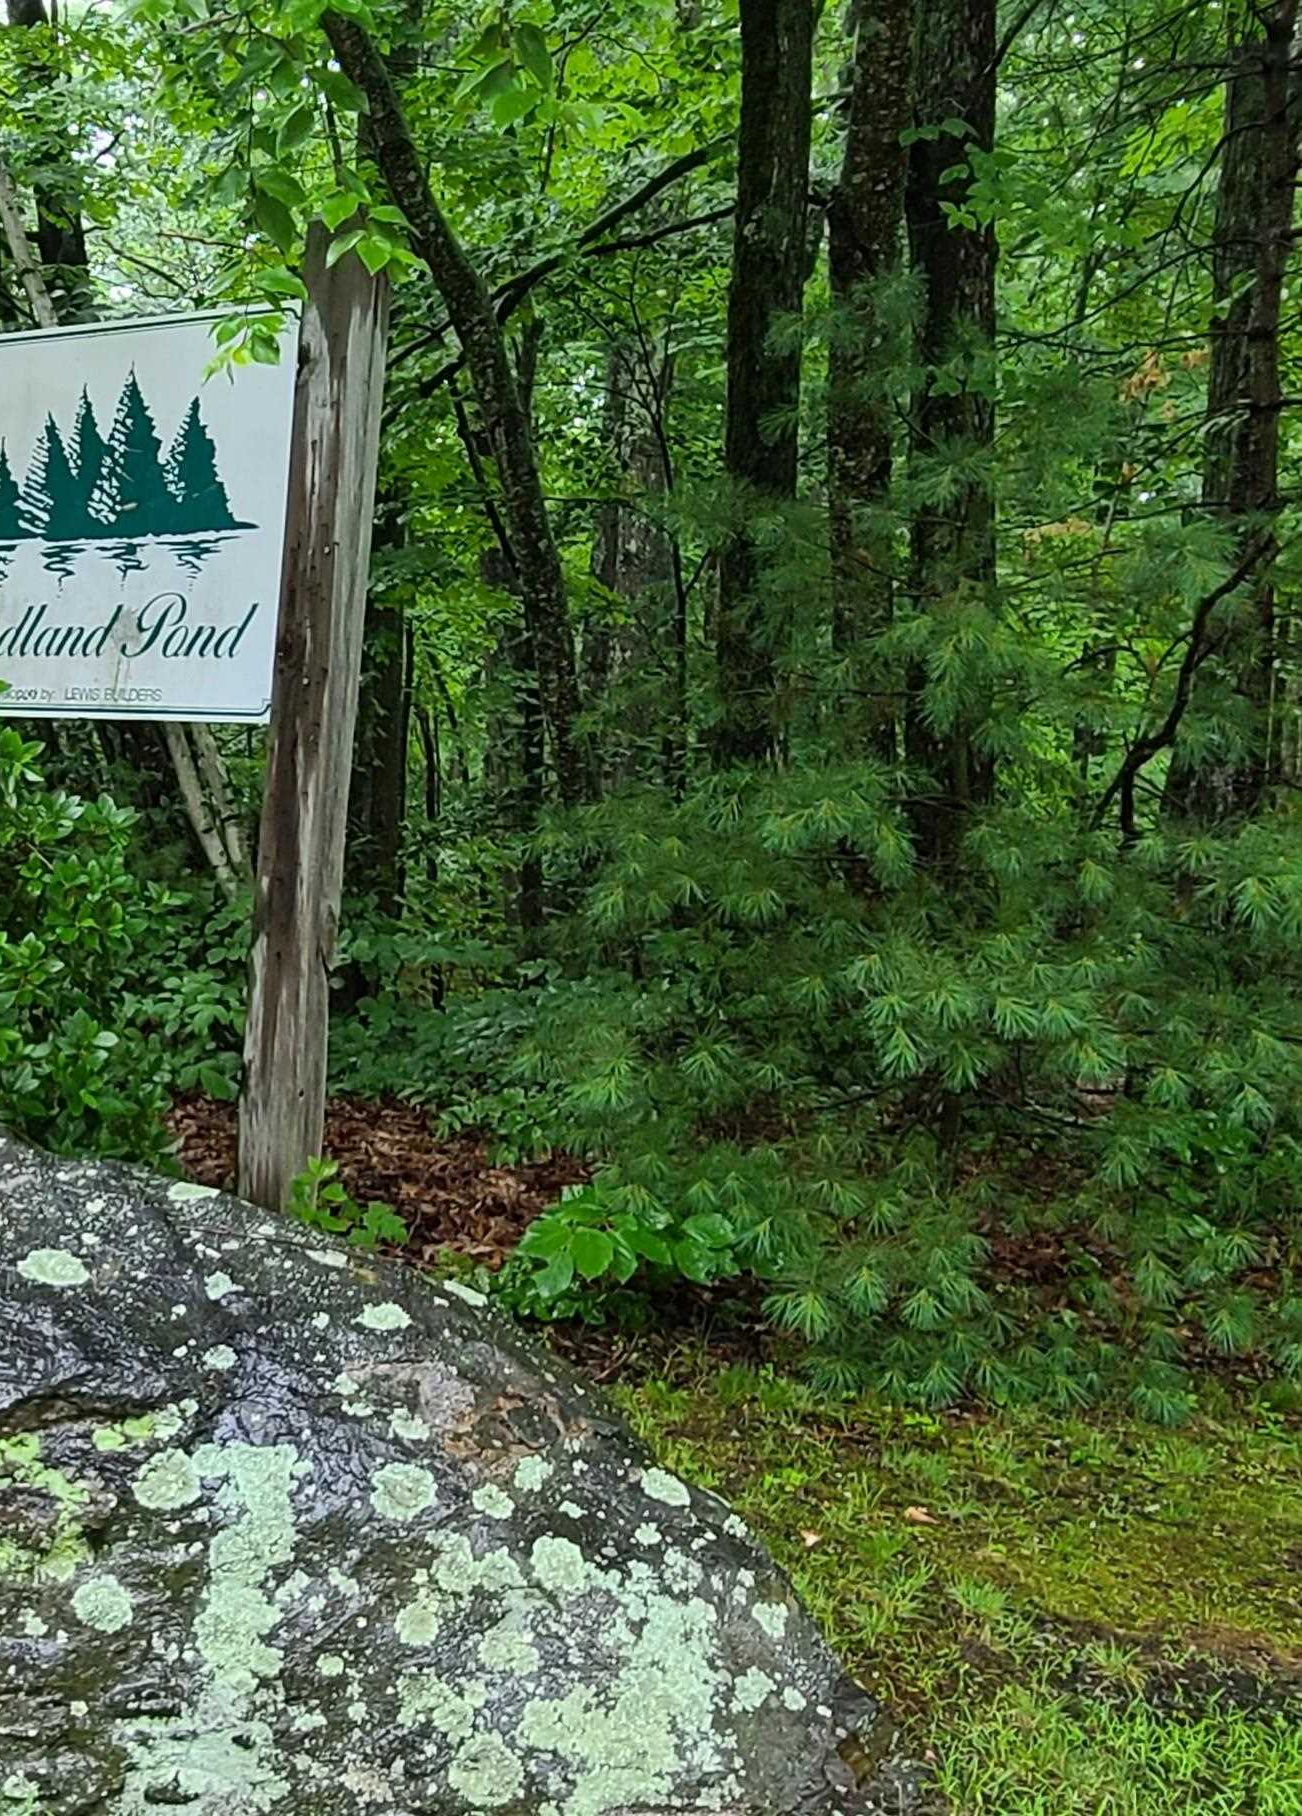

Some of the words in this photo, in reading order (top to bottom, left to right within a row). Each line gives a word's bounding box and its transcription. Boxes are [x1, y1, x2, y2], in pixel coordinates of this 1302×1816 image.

[121, 593, 259, 658] Pond
[65, 686, 100, 701] LEWIS
[104, 687, 162, 702] BUILDERS
